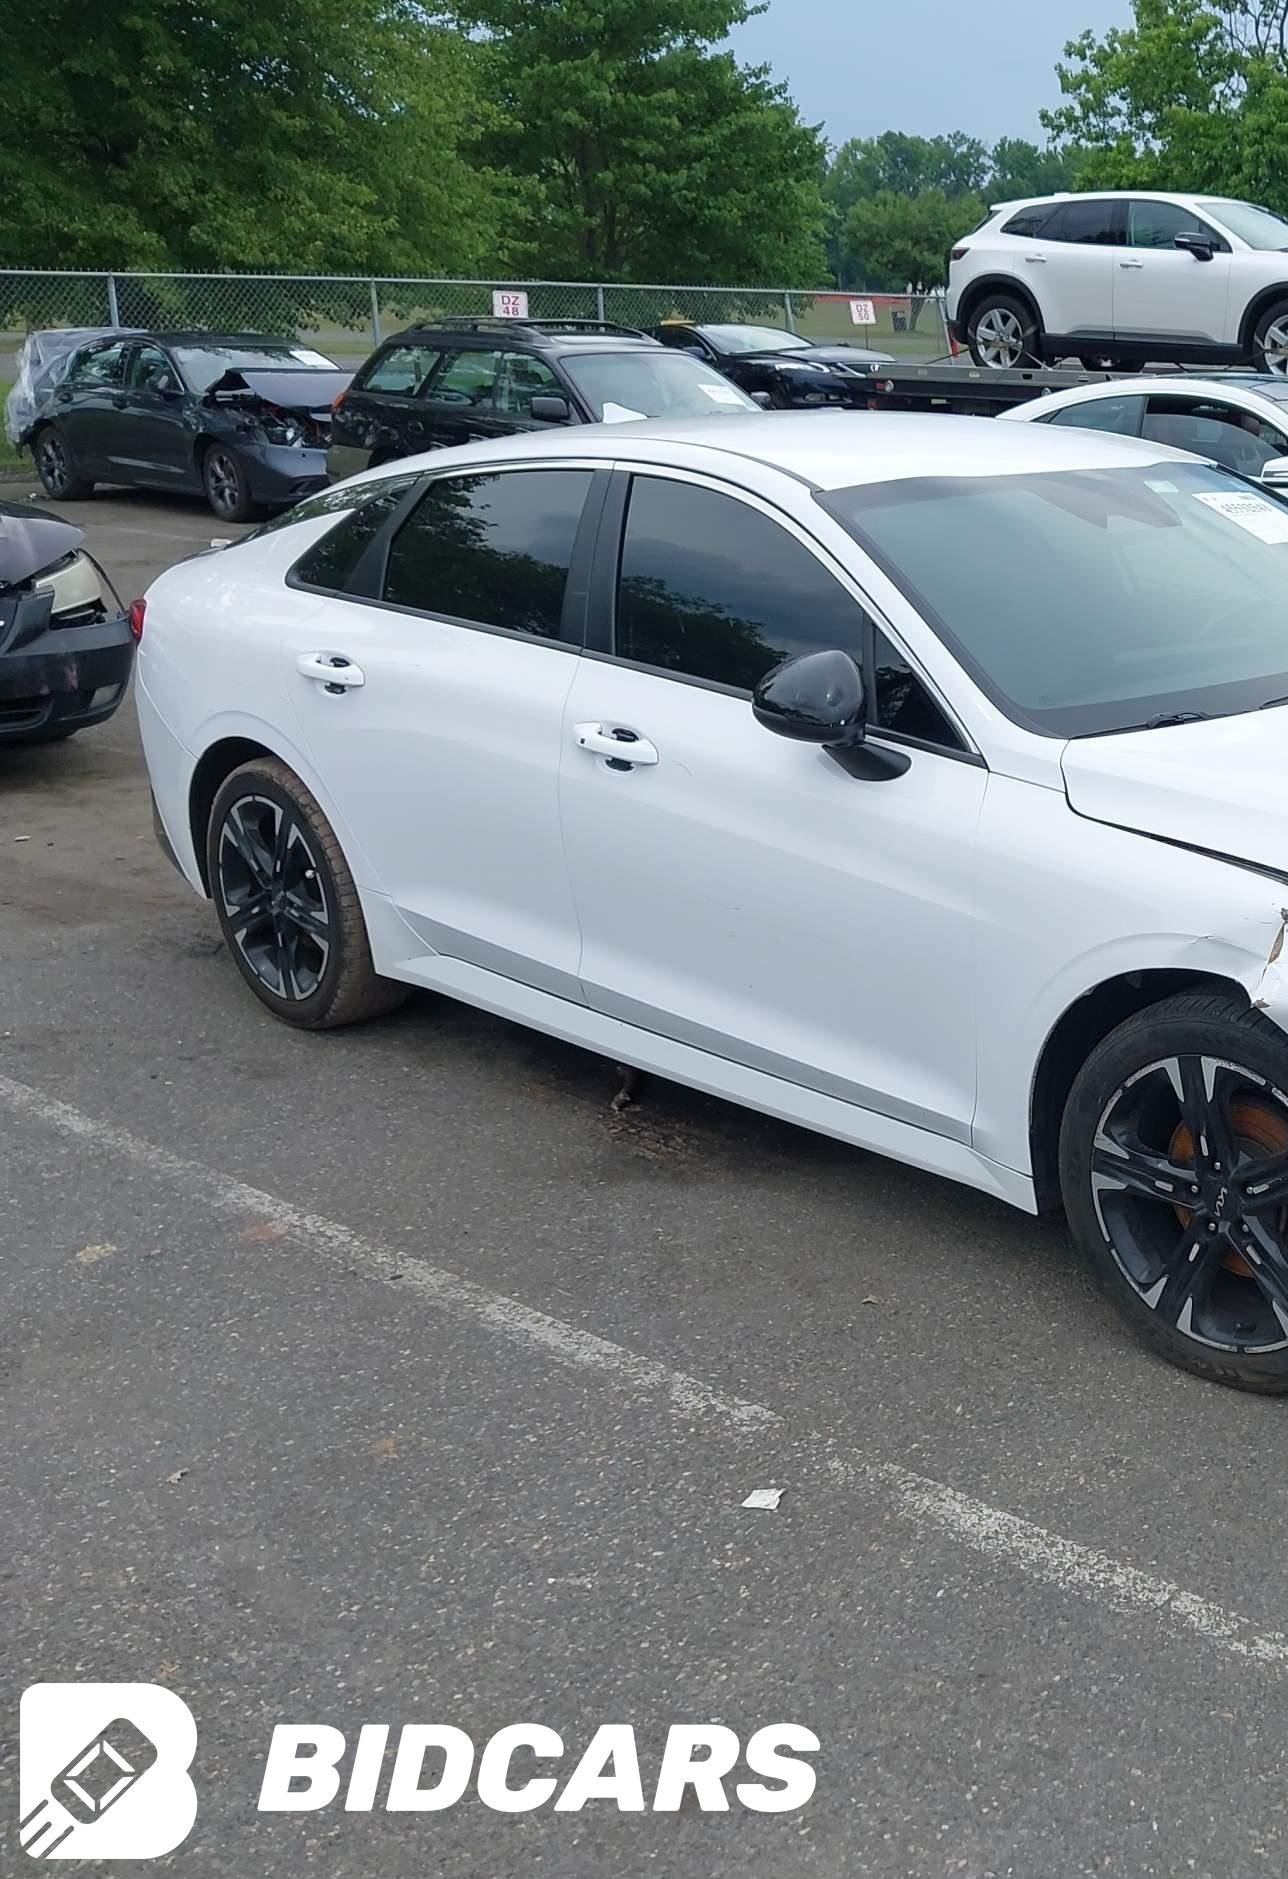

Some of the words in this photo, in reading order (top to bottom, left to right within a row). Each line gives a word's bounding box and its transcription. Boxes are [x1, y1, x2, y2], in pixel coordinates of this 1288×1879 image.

[501, 295, 520, 306] DZ
[502, 306, 519, 316] 48
[856, 303, 868, 313] DZ
[857, 312, 870, 321] 50
